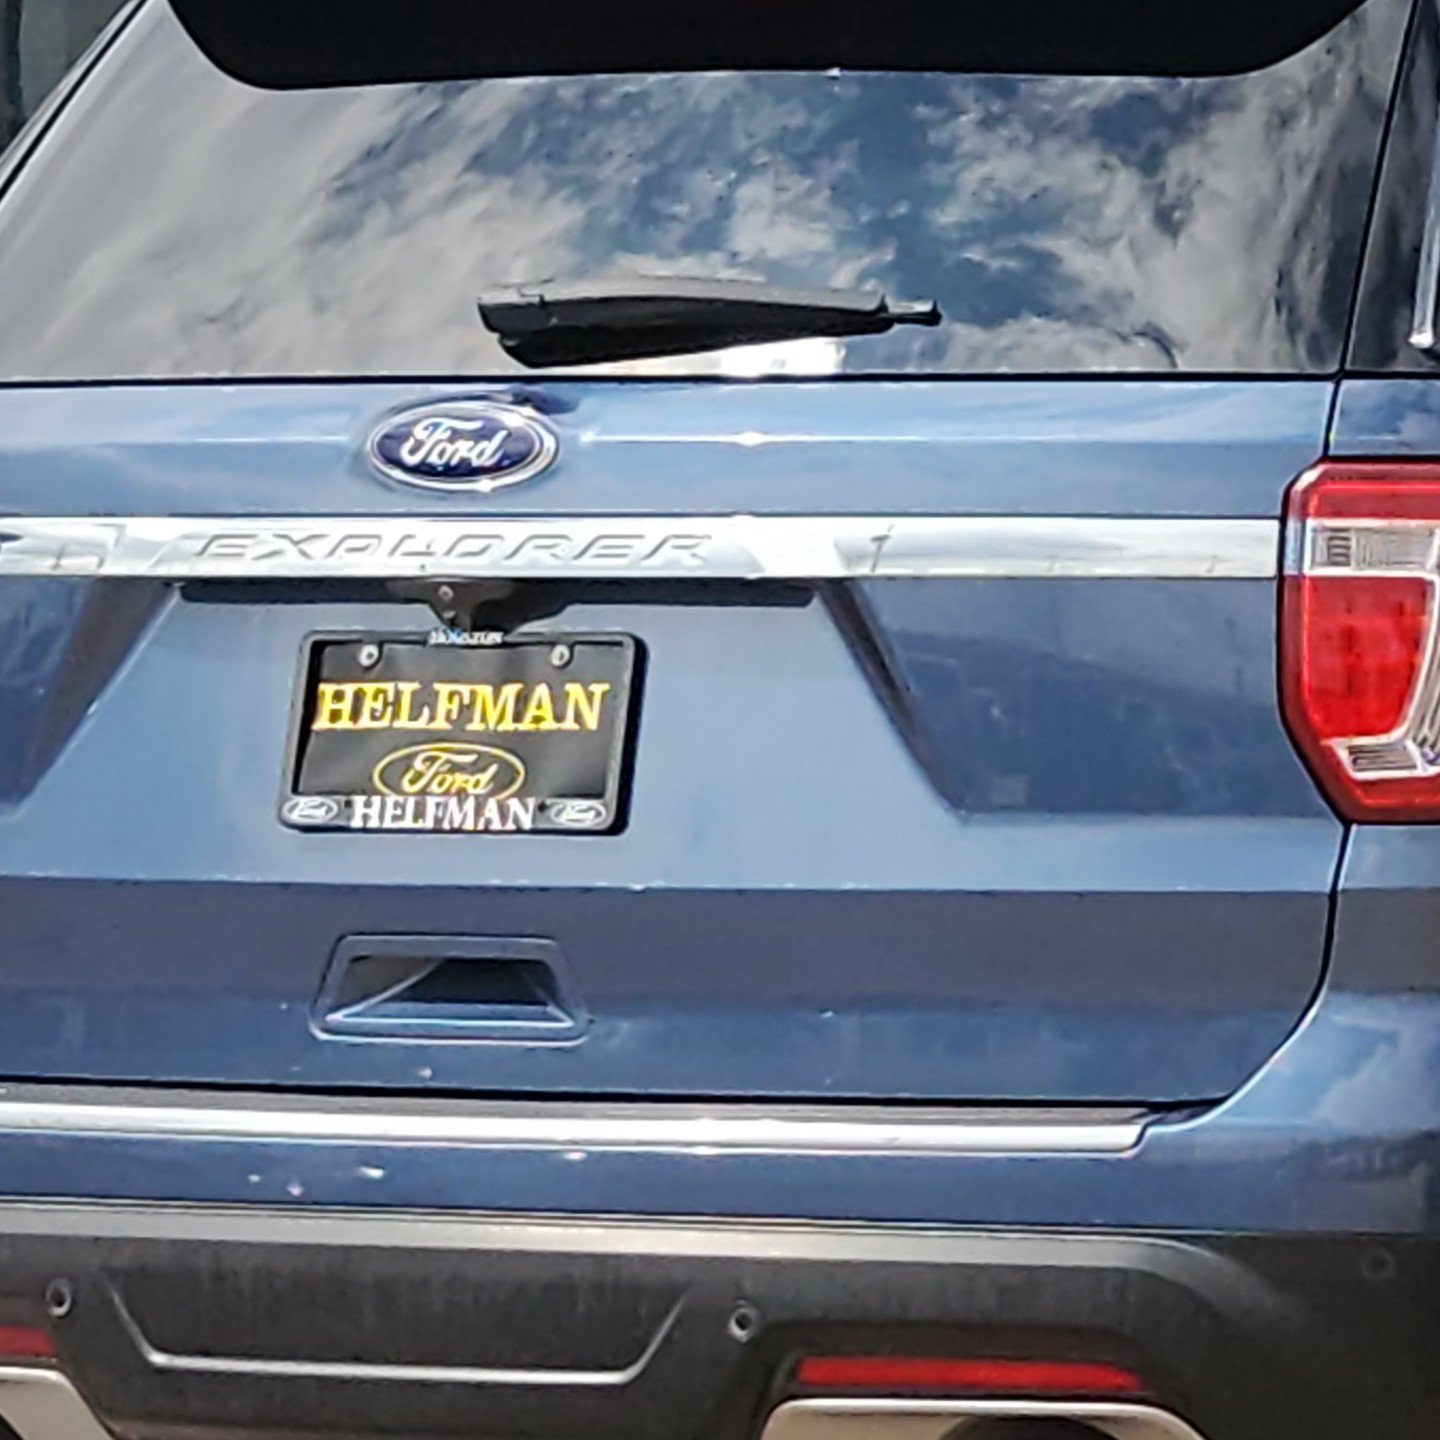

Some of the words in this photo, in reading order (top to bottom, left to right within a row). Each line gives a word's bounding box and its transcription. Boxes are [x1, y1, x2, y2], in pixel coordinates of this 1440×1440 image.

[401, 417, 508, 466] Ford
[194, 532, 713, 562] EXPLORER
[311, 681, 609, 731] HELFMAN
[401, 750, 497, 793] Ford
[350, 795, 536, 830] HELFMAN
